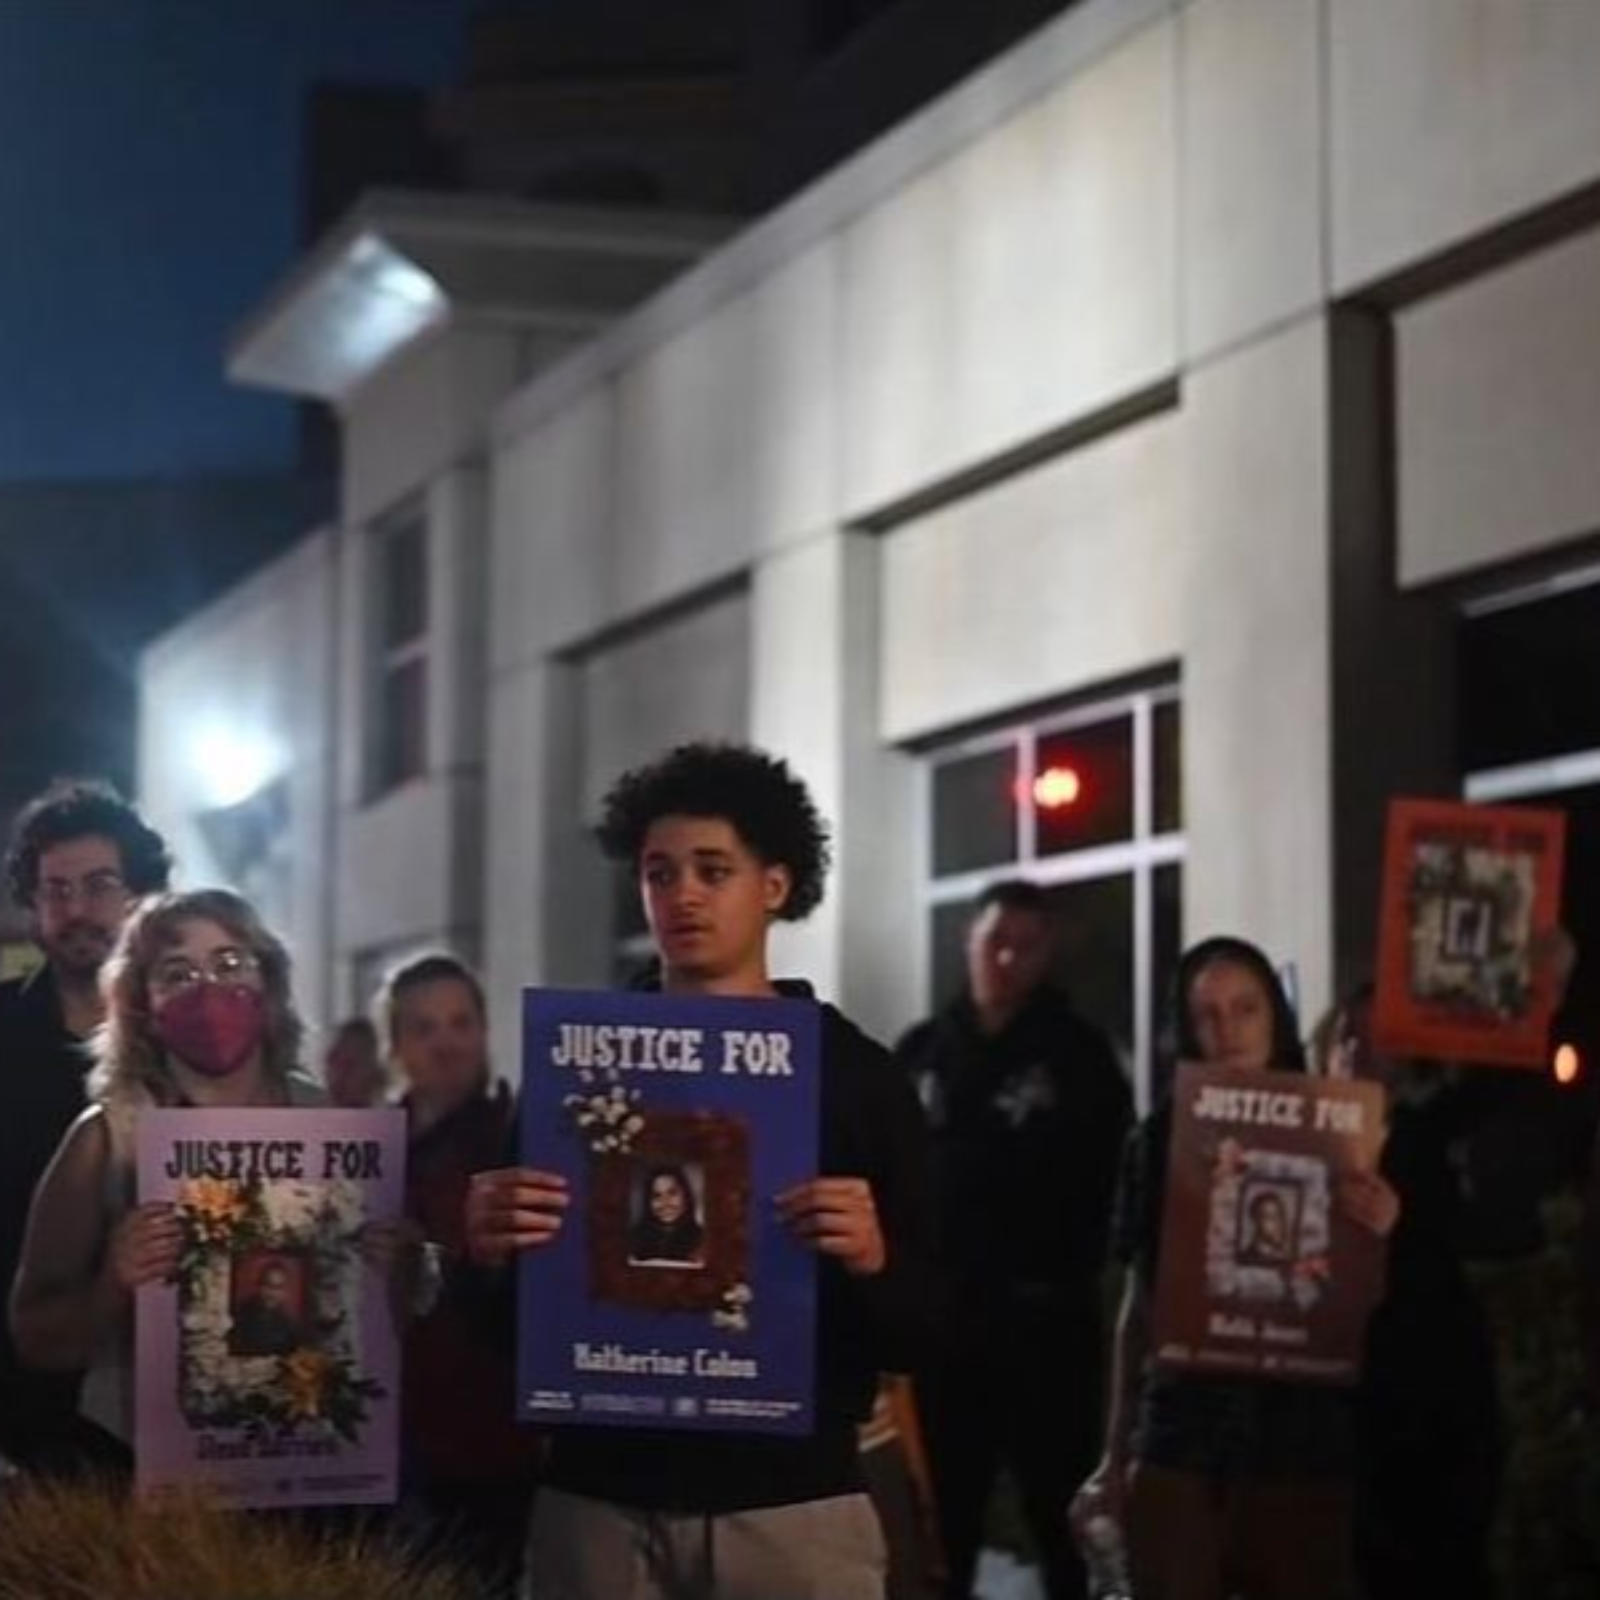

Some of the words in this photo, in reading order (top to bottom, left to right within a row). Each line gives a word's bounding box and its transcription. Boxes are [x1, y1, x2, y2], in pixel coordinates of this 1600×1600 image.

[551, 1024, 703, 1072] JUSTICE
[720, 1030, 793, 1076] FOR
[1193, 1086, 1304, 1127] JUSTICE
[165, 1140, 304, 1180] JUSTICE
[321, 1140, 383, 1180] FOR
